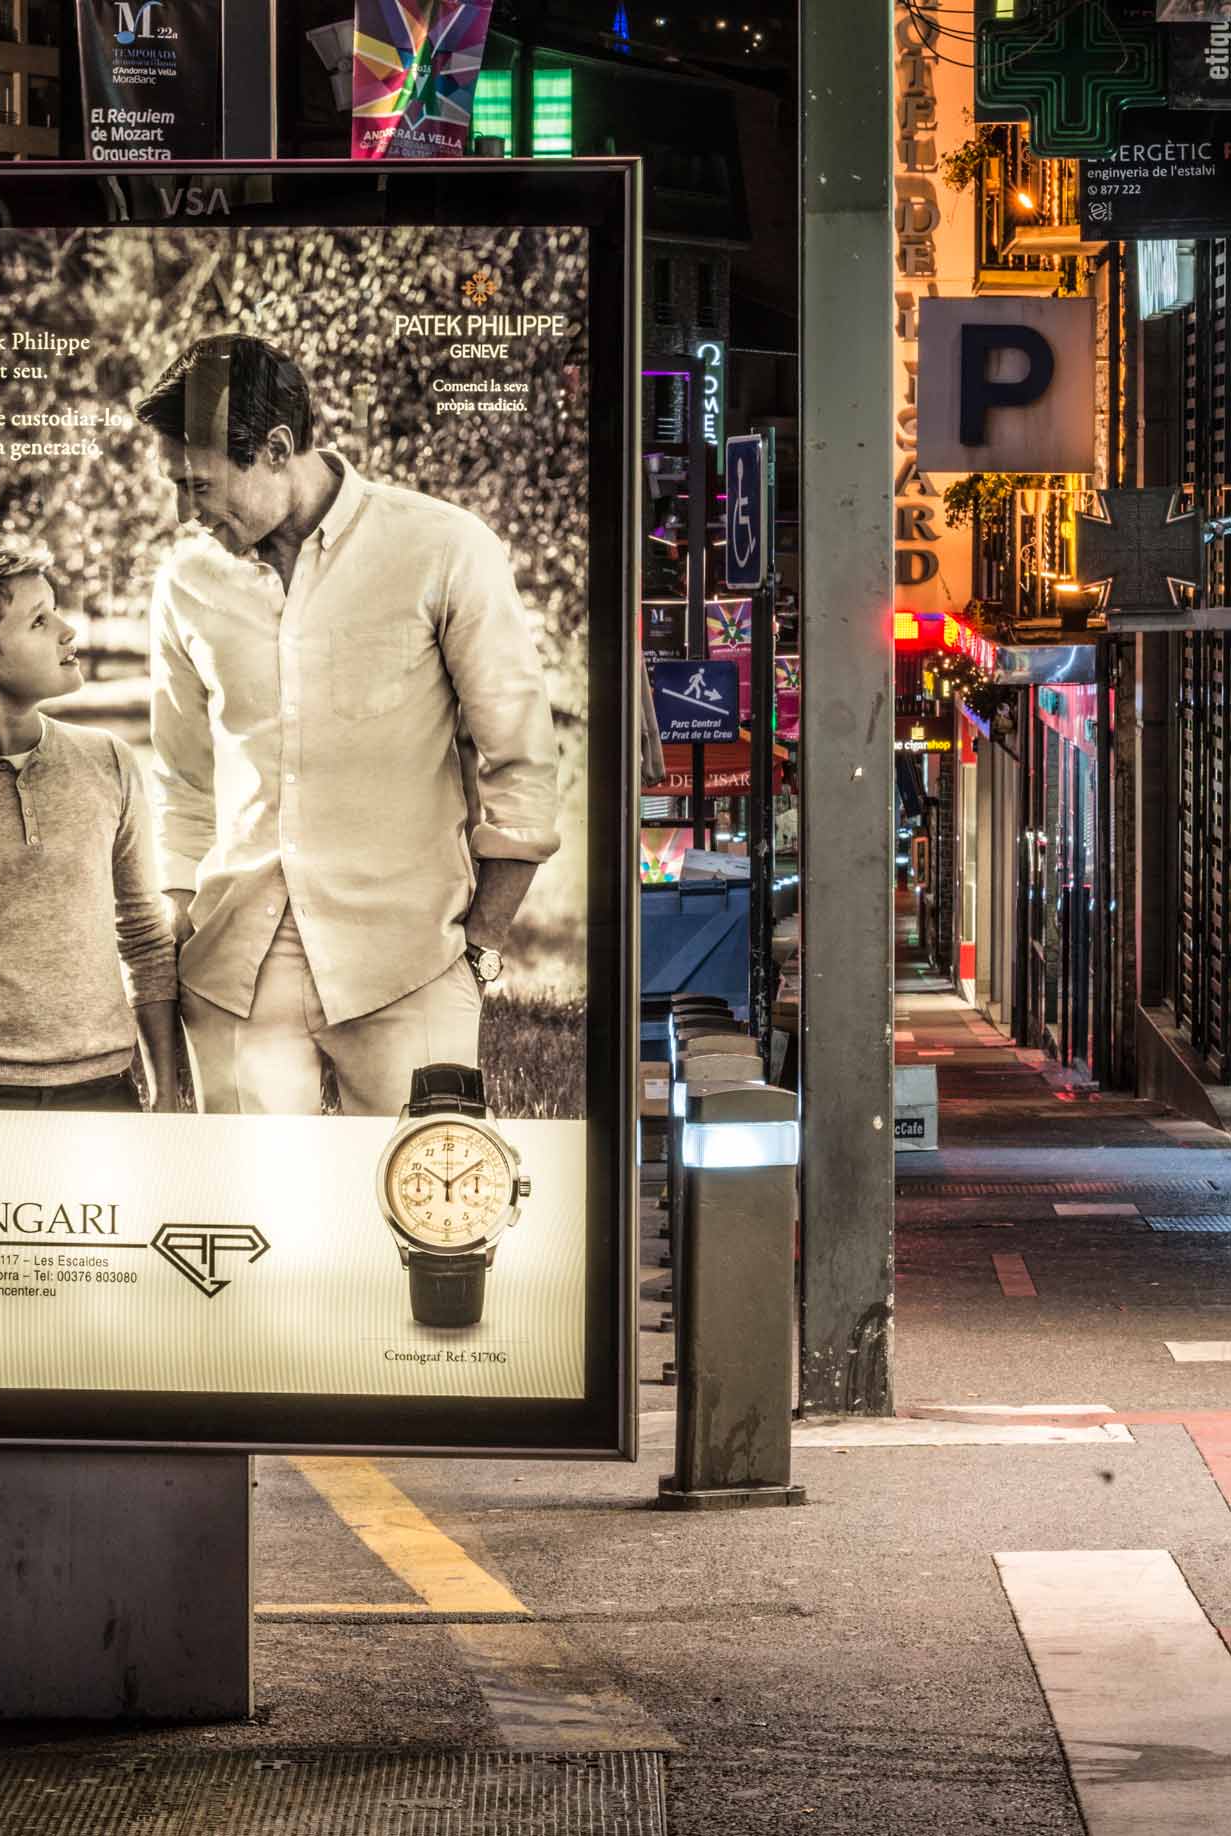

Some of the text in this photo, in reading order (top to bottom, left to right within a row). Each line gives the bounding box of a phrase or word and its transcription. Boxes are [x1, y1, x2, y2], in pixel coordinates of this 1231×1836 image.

[91, 108, 175, 127] El Rèquiem
[91, 127, 165, 142] de Mozart
[413, 131, 426, 143] LA
[428, 134, 462, 149] VELLA
[92, 145, 172, 160] Orquestra
[1088, 140, 1212, 162] ERGÈTIC
[1088, 164, 1215, 180] enginyeria de l'estalvi
[1100, 184, 1142, 195] 877 222
[395, 315, 564, 337] PATEK PHILIPPE
[12, 332, 90, 356] Philippe
[449, 344, 509, 359] GENEVE
[14, 366, 48, 379] seu.
[433, 379, 529, 392] Comenci la seva
[960, 324, 1055, 446] P
[436, 398, 528, 415] pròpia tradició.
[10, 436, 103, 460] generació.
[671, 719, 721, 728] Parc Central
[672, 731, 689, 740] Prat
[691, 731, 702, 740] de
[704, 731, 712, 740] la
[713, 730, 732, 739] Creu
[1, 1254, 20, 1265] 117
[34, 1255, 54, 1267] Les
[58, 1255, 109, 1268] Escaldes
[34, 1270, 53, 1281] Tel:
[57, 1271, 92, 1282] 00376
[95, 1271, 137, 1284] 803080
